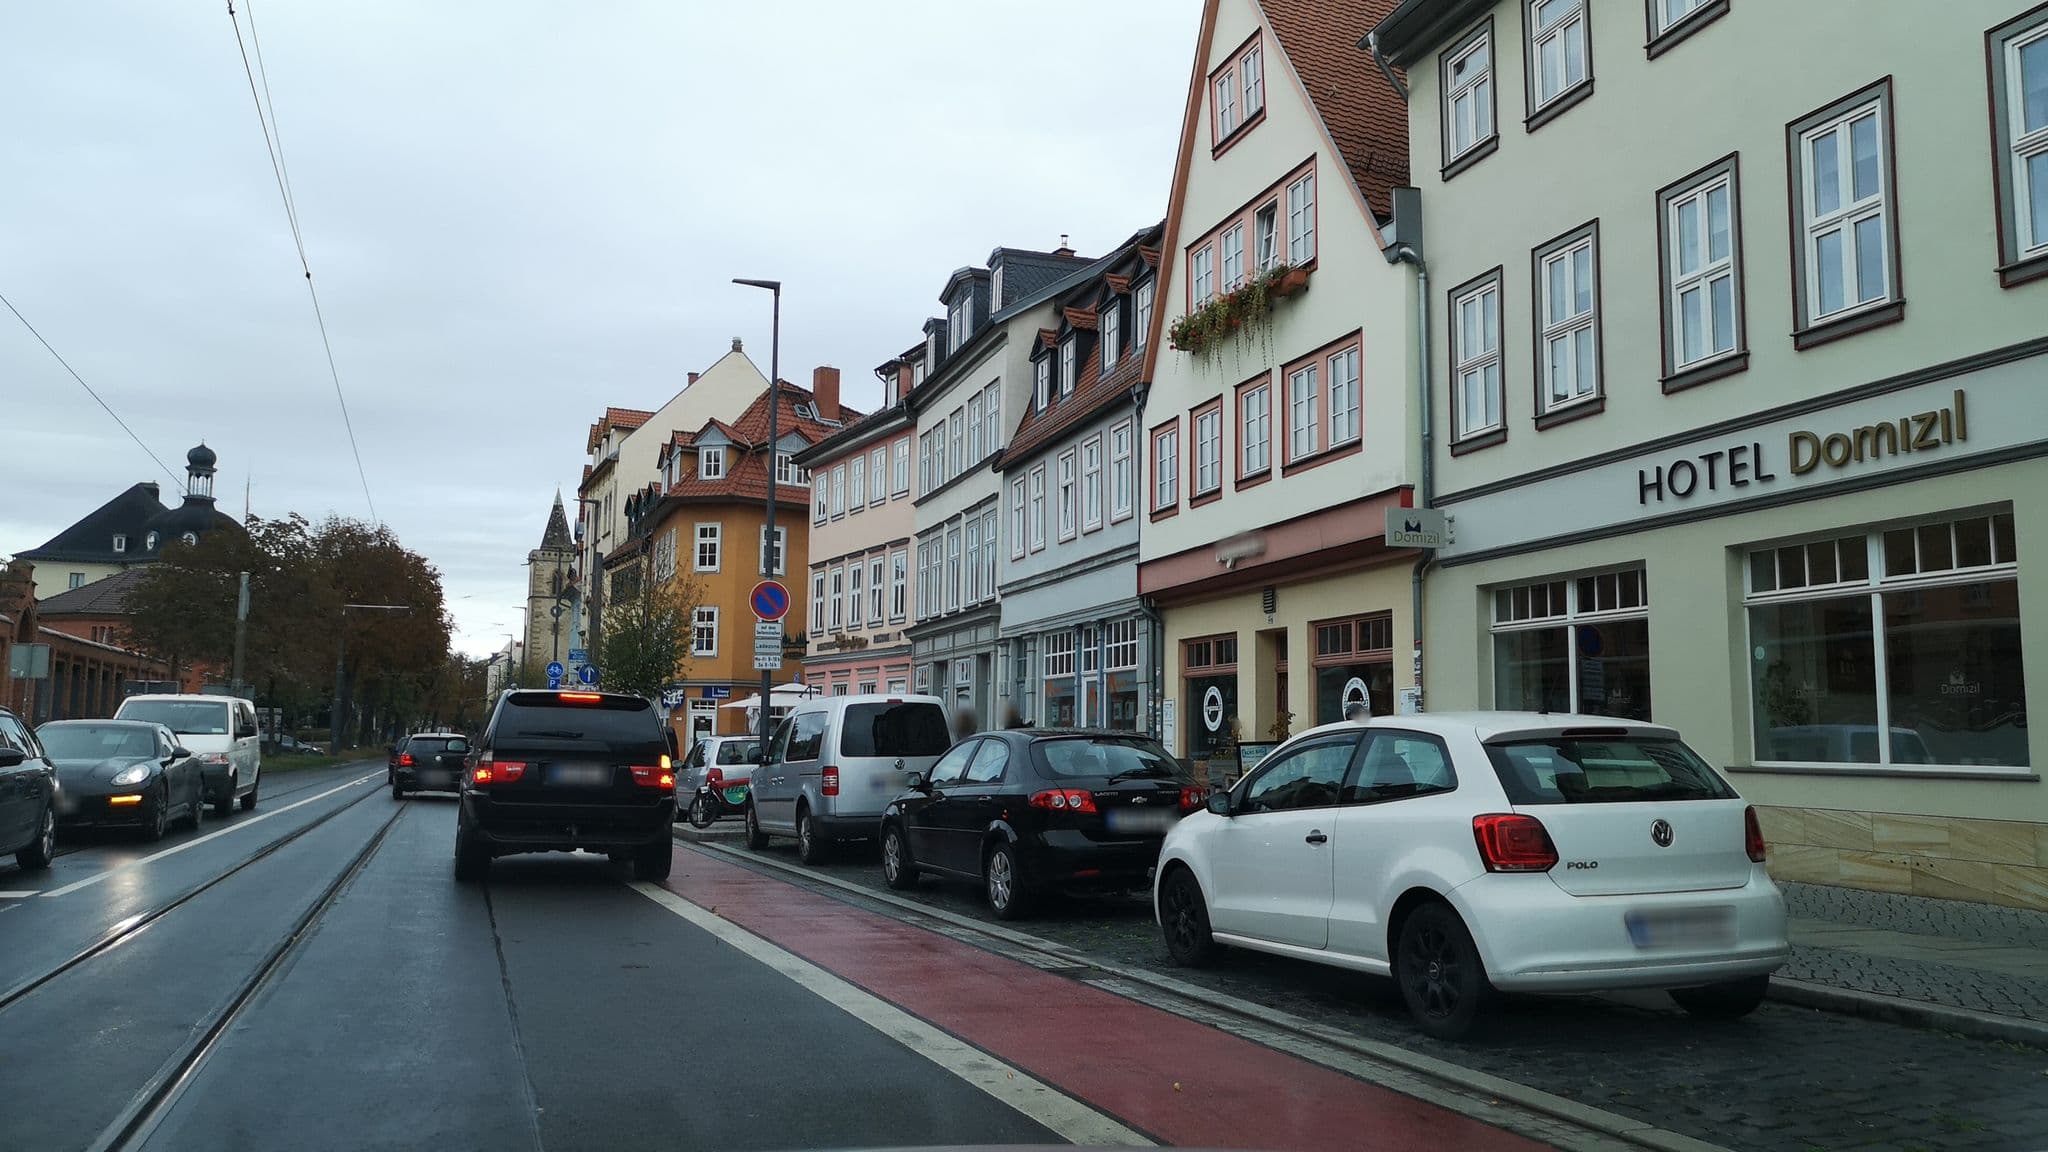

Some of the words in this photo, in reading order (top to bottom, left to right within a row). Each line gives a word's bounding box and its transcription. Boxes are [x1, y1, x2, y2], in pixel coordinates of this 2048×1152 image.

[1638, 442, 1775, 505] HOTEL
[1788, 388, 1967, 476] Domizil
[1394, 530, 1440, 545] Domizil
[549, 680, 556, 688] P
[1566, 860, 1599, 870] POLO
